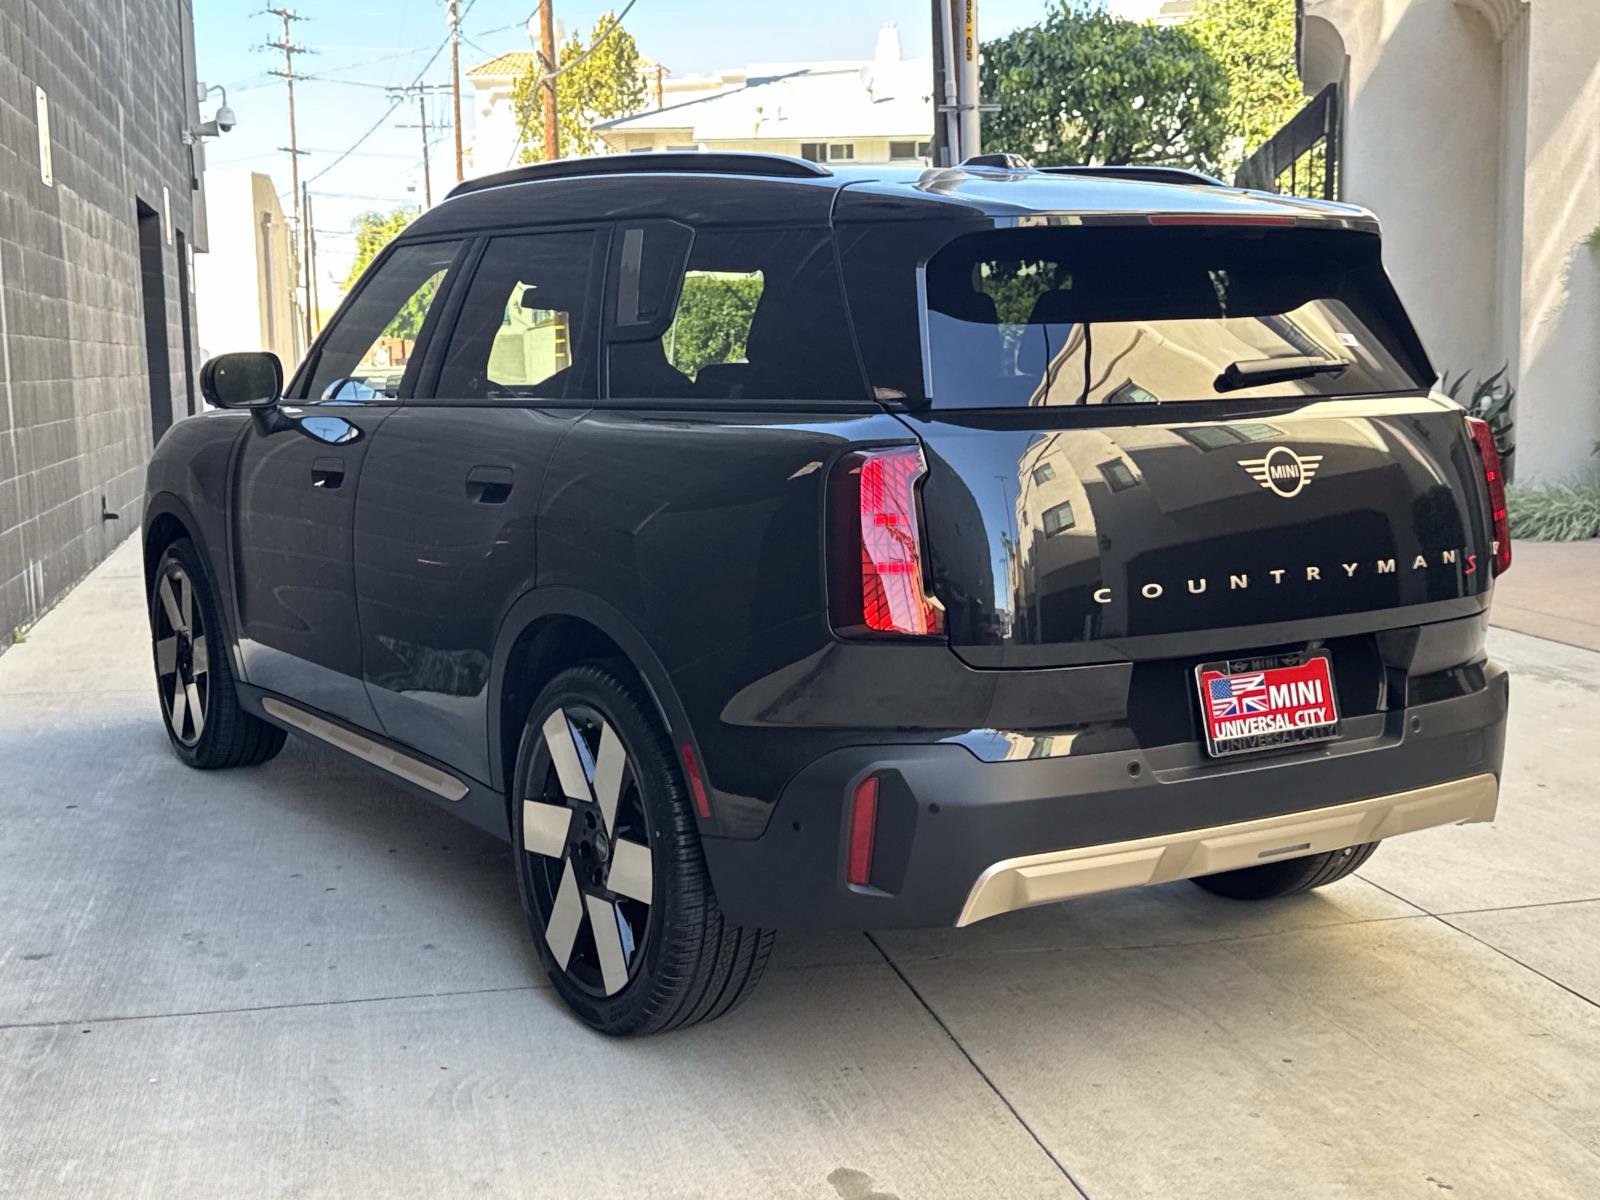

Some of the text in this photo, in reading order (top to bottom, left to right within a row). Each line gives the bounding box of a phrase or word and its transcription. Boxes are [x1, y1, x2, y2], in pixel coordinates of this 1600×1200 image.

[1269, 464, 1300, 479] MINI
[1093, 549, 1477, 604] COUNTRYMAN S
[1269, 679, 1323, 709] MINI
[1215, 707, 1327, 738] UNIVERSAL CITY
[1219, 725, 1338, 752] UNIVERSAL CITY
